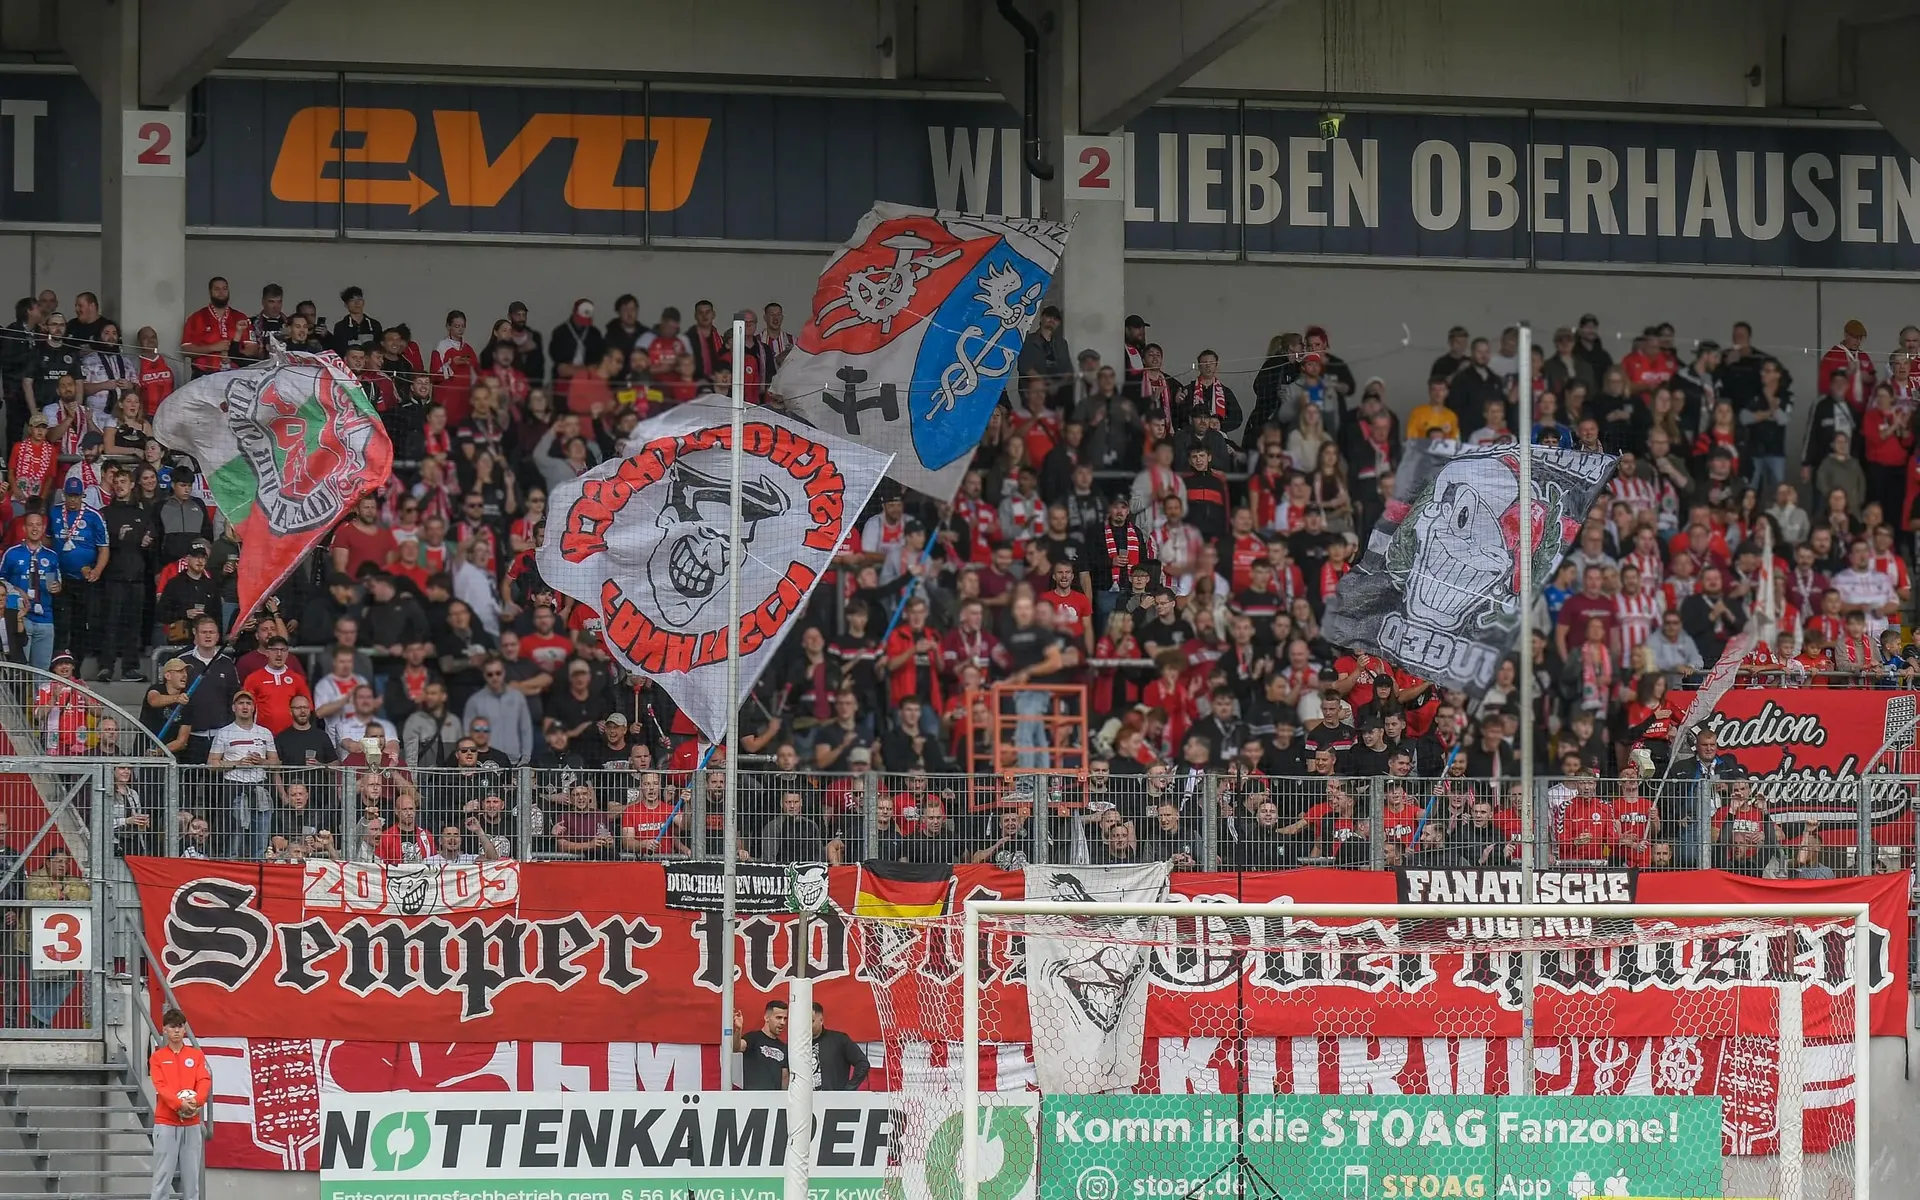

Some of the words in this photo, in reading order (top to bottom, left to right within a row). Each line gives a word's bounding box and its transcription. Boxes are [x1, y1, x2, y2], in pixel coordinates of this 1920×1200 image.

[137, 122, 172, 165] 2
[270, 106, 711, 214] evo
[928, 126, 1041, 219] WI
[1124, 131, 1380, 228] LIEBEN
[1411, 139, 1920, 244] OBERHAUSEN
[1078, 146, 1111, 189] 2
[666, 873, 751, 895] DURCHHAEN
[1406, 870, 1630, 903] FANATISCHE
[42, 912, 83, 962] 3
[161, 877, 662, 1022] Semper
[1056, 1110, 1191, 1143] Komm
[1203, 1109, 1239, 1143] in
[1248, 1108, 1310, 1143] die
[1320, 1109, 1488, 1148] STOAG
[1498, 1111, 1678, 1144] Fanzone!
[1382, 1174, 1485, 1199] STOAG
[1499, 1173, 1551, 1200] App
